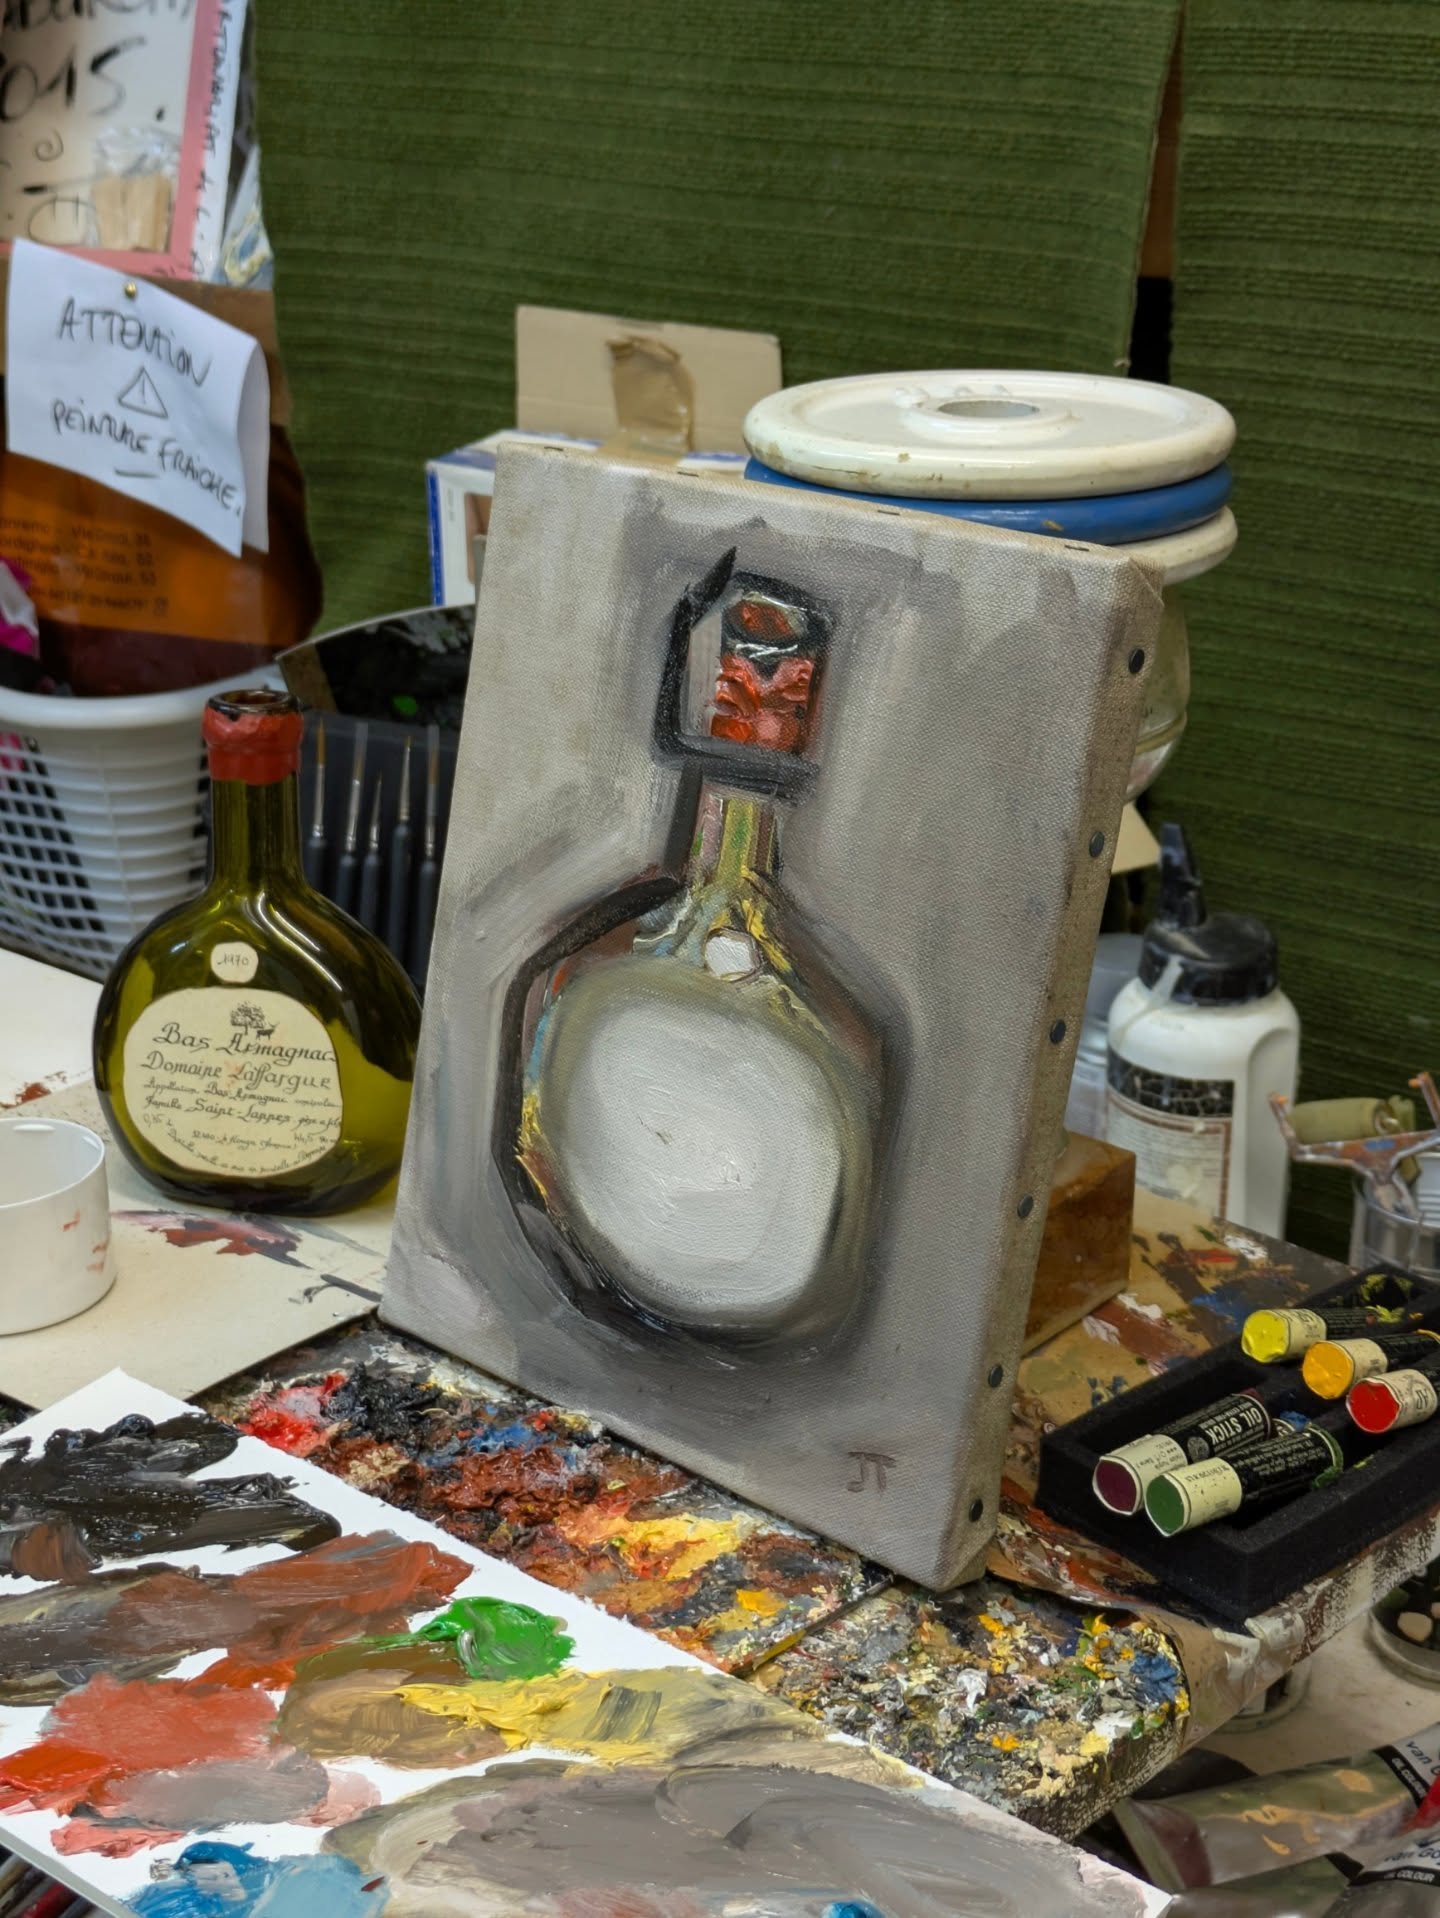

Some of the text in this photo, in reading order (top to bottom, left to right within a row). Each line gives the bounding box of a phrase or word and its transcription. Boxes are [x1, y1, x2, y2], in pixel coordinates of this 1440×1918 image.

[152, 1021, 337, 1068] Bas Armagnac
[140, 1050, 331, 1096] Domaine Laffargue
[1239, 1407, 1262, 1428] OIL
[1205, 1417, 1242, 1446] STICK
[1406, 1741, 1433, 1765] van
[1396, 1869, 1435, 1883] COLOUR
